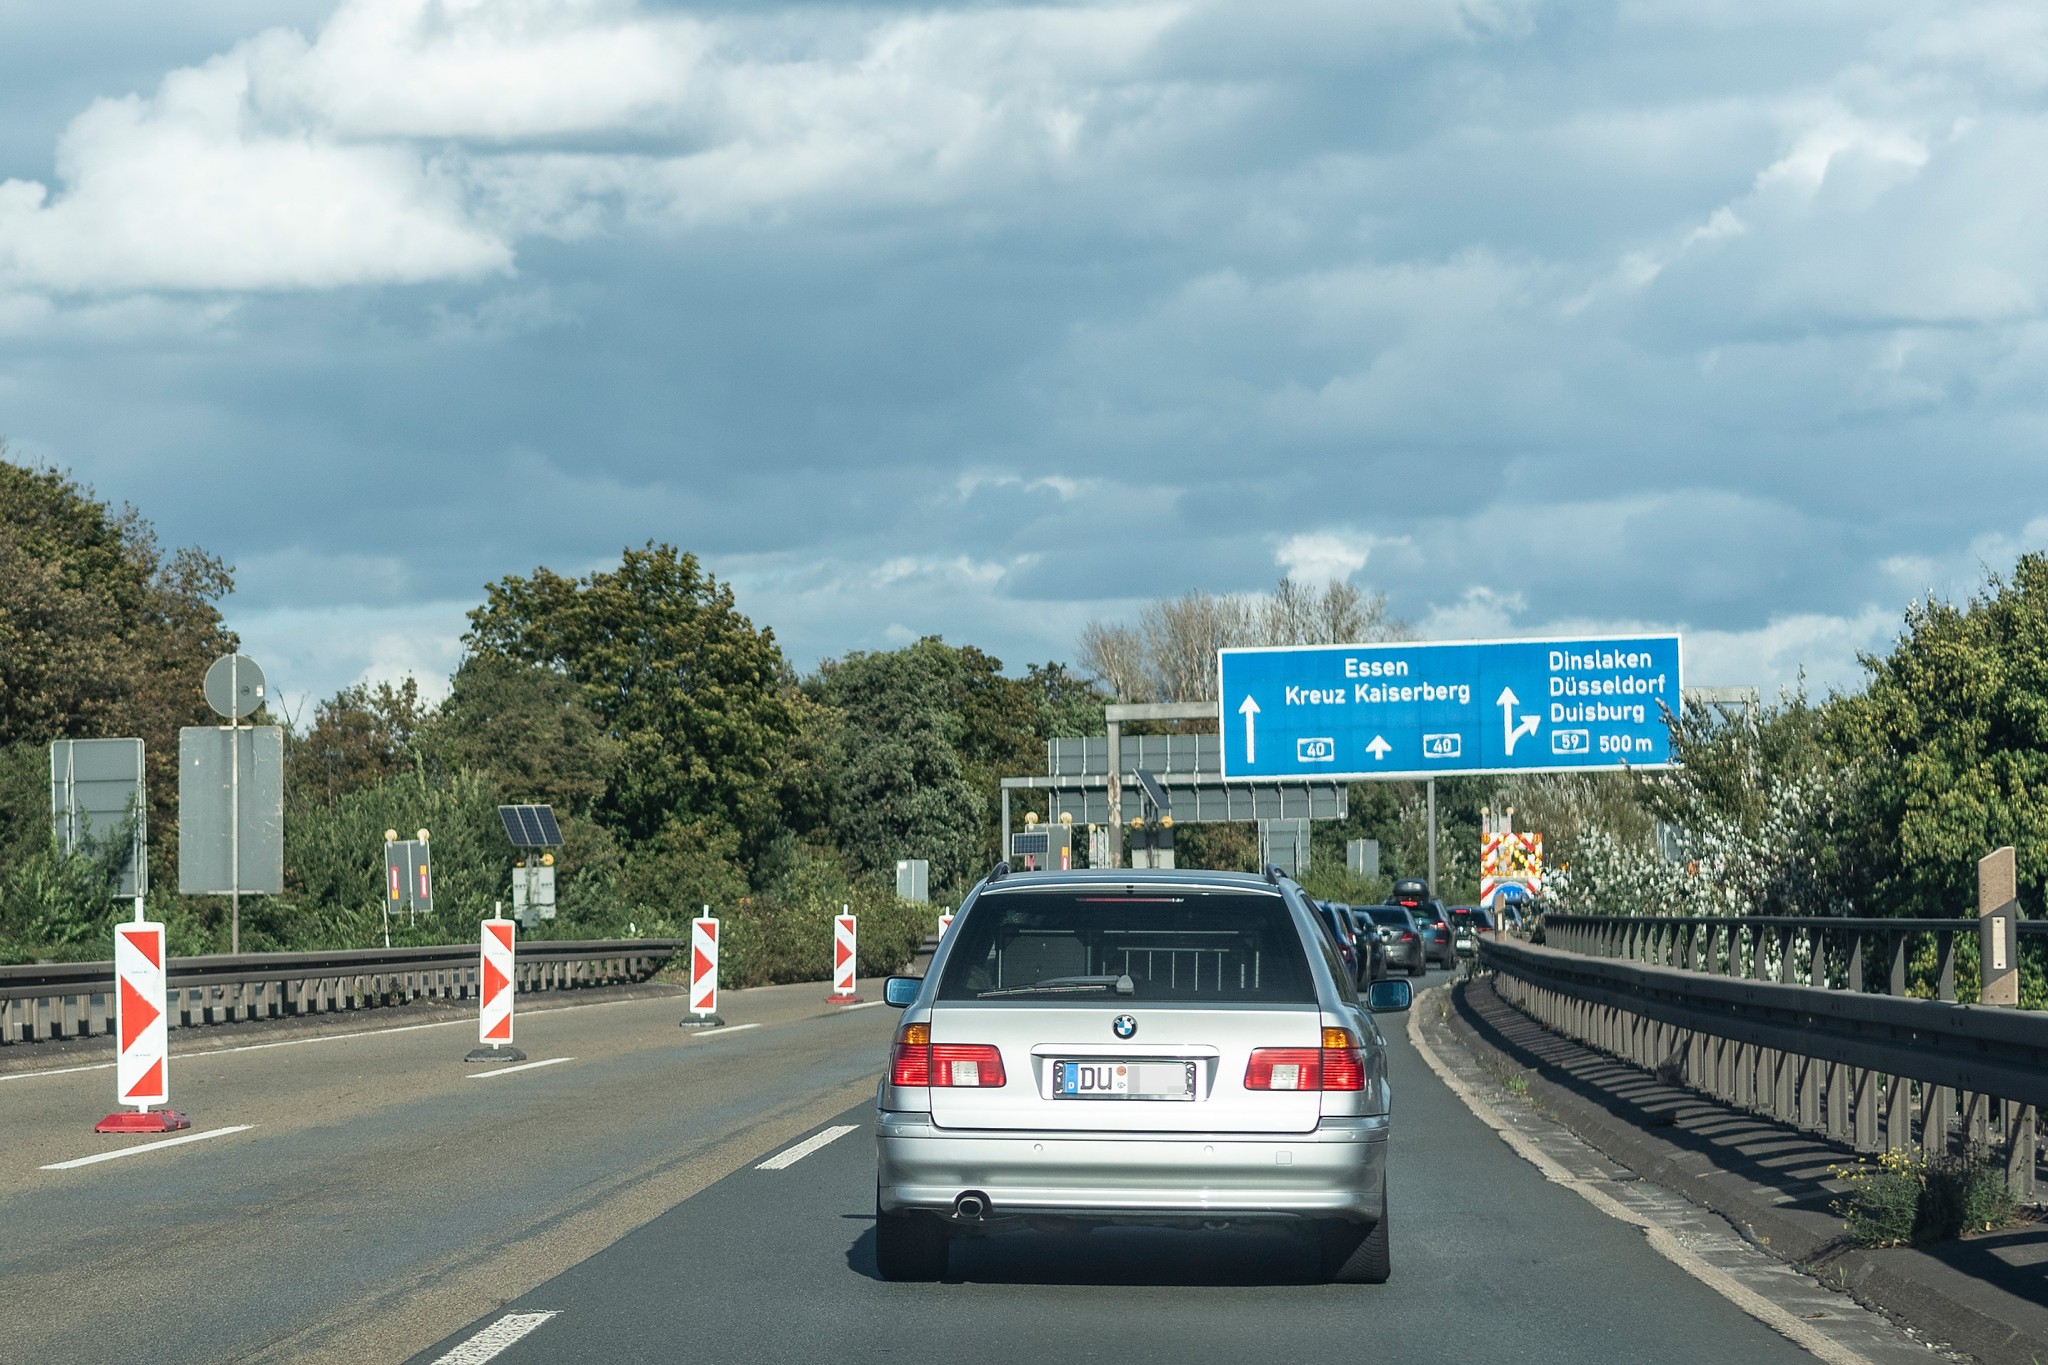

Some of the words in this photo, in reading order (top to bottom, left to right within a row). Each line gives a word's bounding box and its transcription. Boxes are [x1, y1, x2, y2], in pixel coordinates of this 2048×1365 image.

[1345, 657, 1409, 678] Essen
[1549, 649, 1652, 672] Dinslaken
[1285, 685, 1346, 706] Kreuz
[1354, 681, 1471, 705] Kaiserberg
[1549, 673, 1666, 697] Düsseldorf
[1550, 701, 1645, 724] Duisburg
[1306, 742, 1325, 758] 40
[1432, 738, 1452, 754] 40
[1561, 734, 1579, 750] 59
[1599, 734, 1632, 754] 500
[1635, 737, 1652, 752] m
[1068, 1081, 1075, 1089] D
[1080, 1067, 1112, 1090] DU
